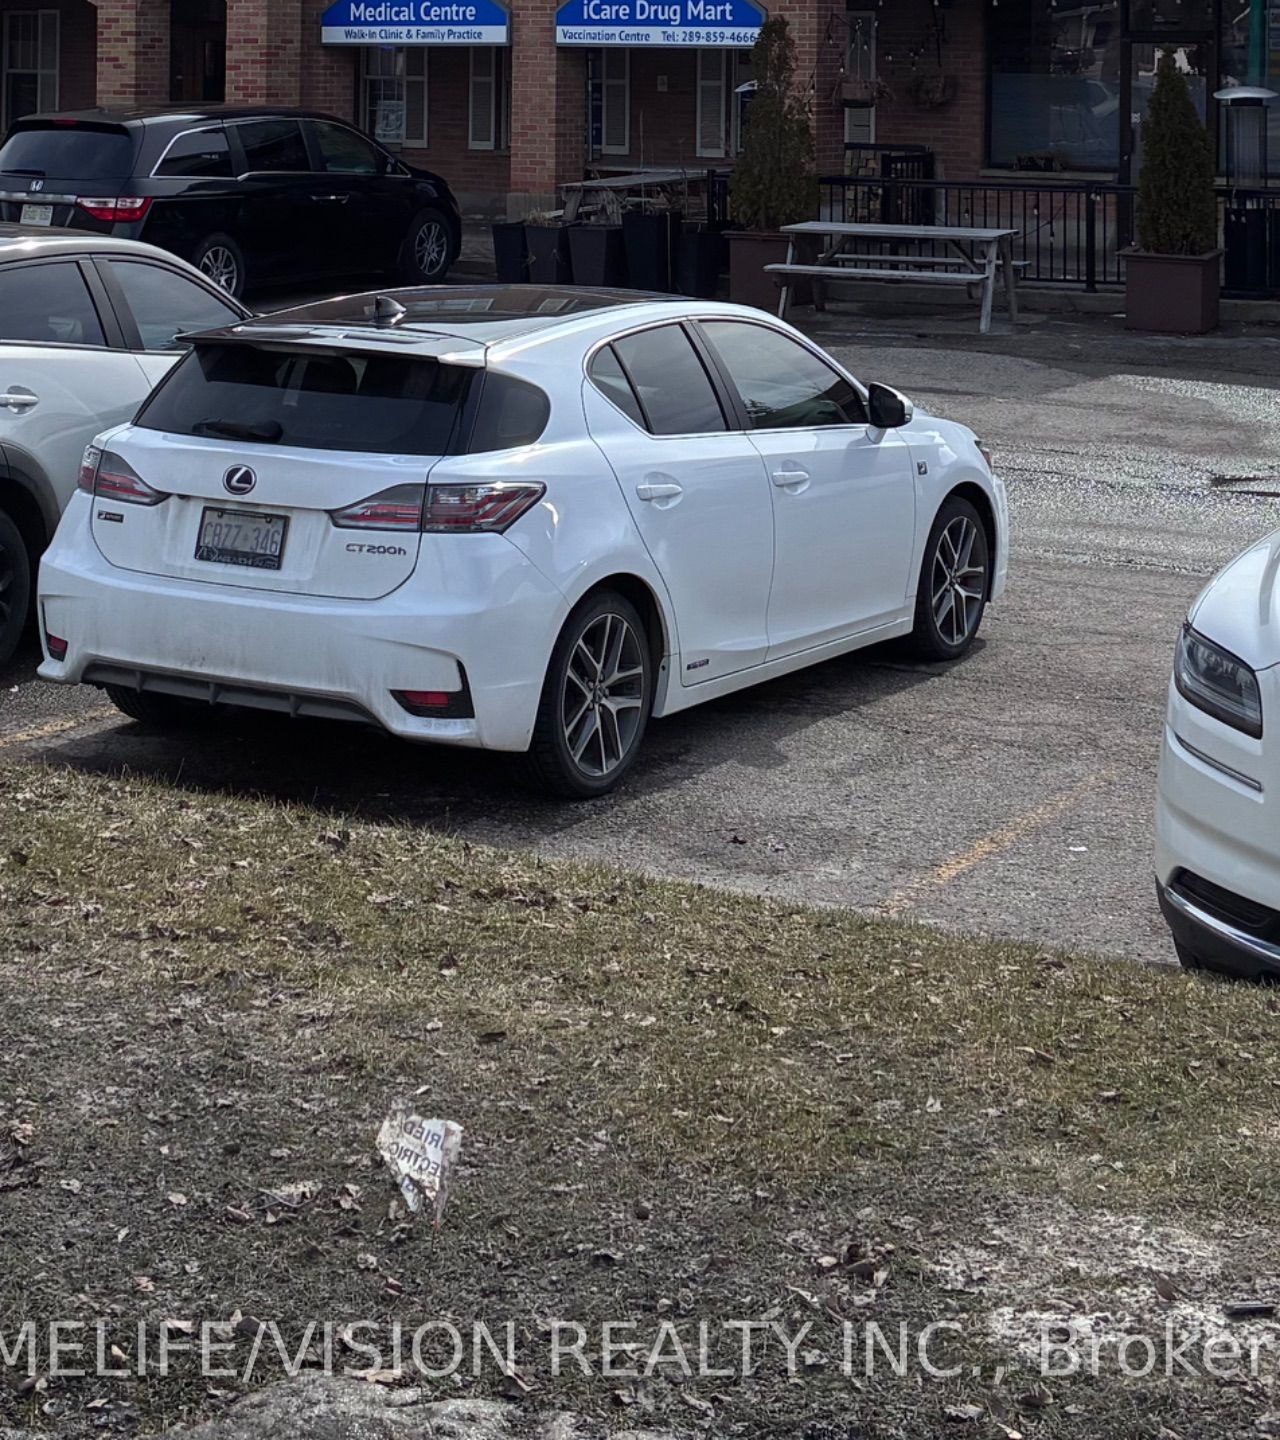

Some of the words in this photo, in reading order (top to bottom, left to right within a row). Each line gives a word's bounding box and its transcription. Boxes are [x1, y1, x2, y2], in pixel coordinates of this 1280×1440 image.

[350, 2, 416, 22] Medical
[420, 2, 476, 21] Centre
[583, 0, 630, 21] iCare
[635, 0, 681, 25] Drug
[687, 0, 734, 21] Mart
[344, 28, 377, 40] Walk-In
[378, 28, 403, 40] Clinic
[405, 29, 414, 40] &
[416, 29, 446, 41] Family
[447, 29, 483, 40] Practice
[561, 28, 617, 41] Vaccination
[618, 30, 651, 42] Centre
[661, 30, 679, 42] Tel:
[681, 31, 756, 43] 289-859-4666
[249, 527, 281, 554] 346
[345, 541, 408, 557] CT200h
